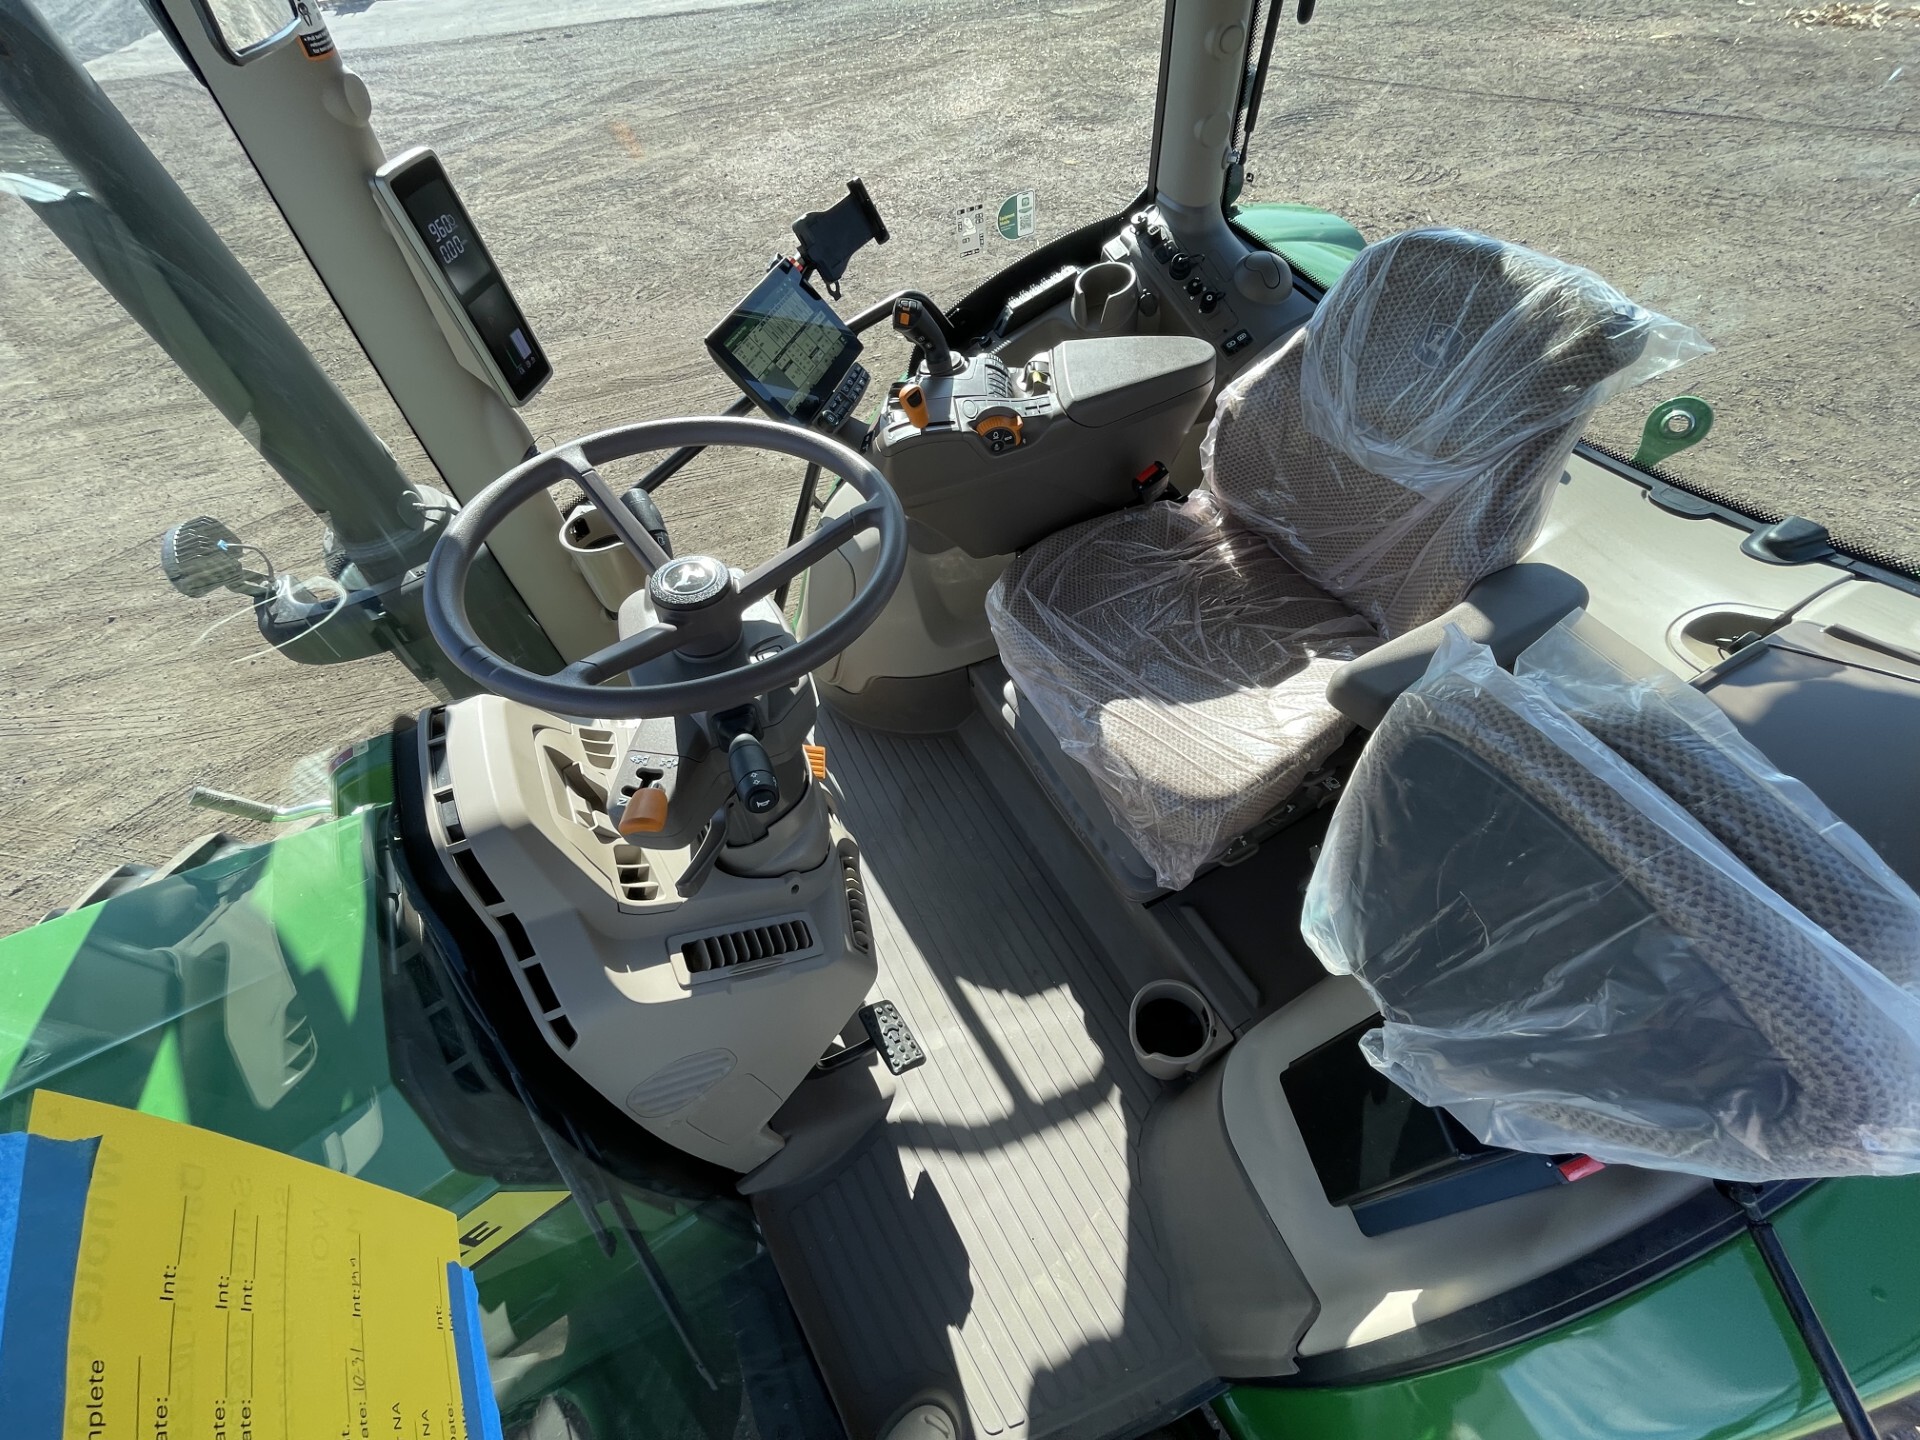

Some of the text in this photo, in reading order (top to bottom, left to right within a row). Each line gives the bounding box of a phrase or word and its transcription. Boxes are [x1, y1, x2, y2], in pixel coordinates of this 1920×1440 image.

[428, 214, 453, 243] 960
[439, 235, 465, 264] 0.00
[160, 1265, 177, 1301] Int:
[215, 1275, 229, 1309] Int:
[241, 1279, 253, 1312] Int:
[352, 1289, 361, 1318] Int:
[436, 1305, 444, 1330] Int:
[392, 1402, 402, 1430] NA
[421, 1409, 431, 1436] NA
